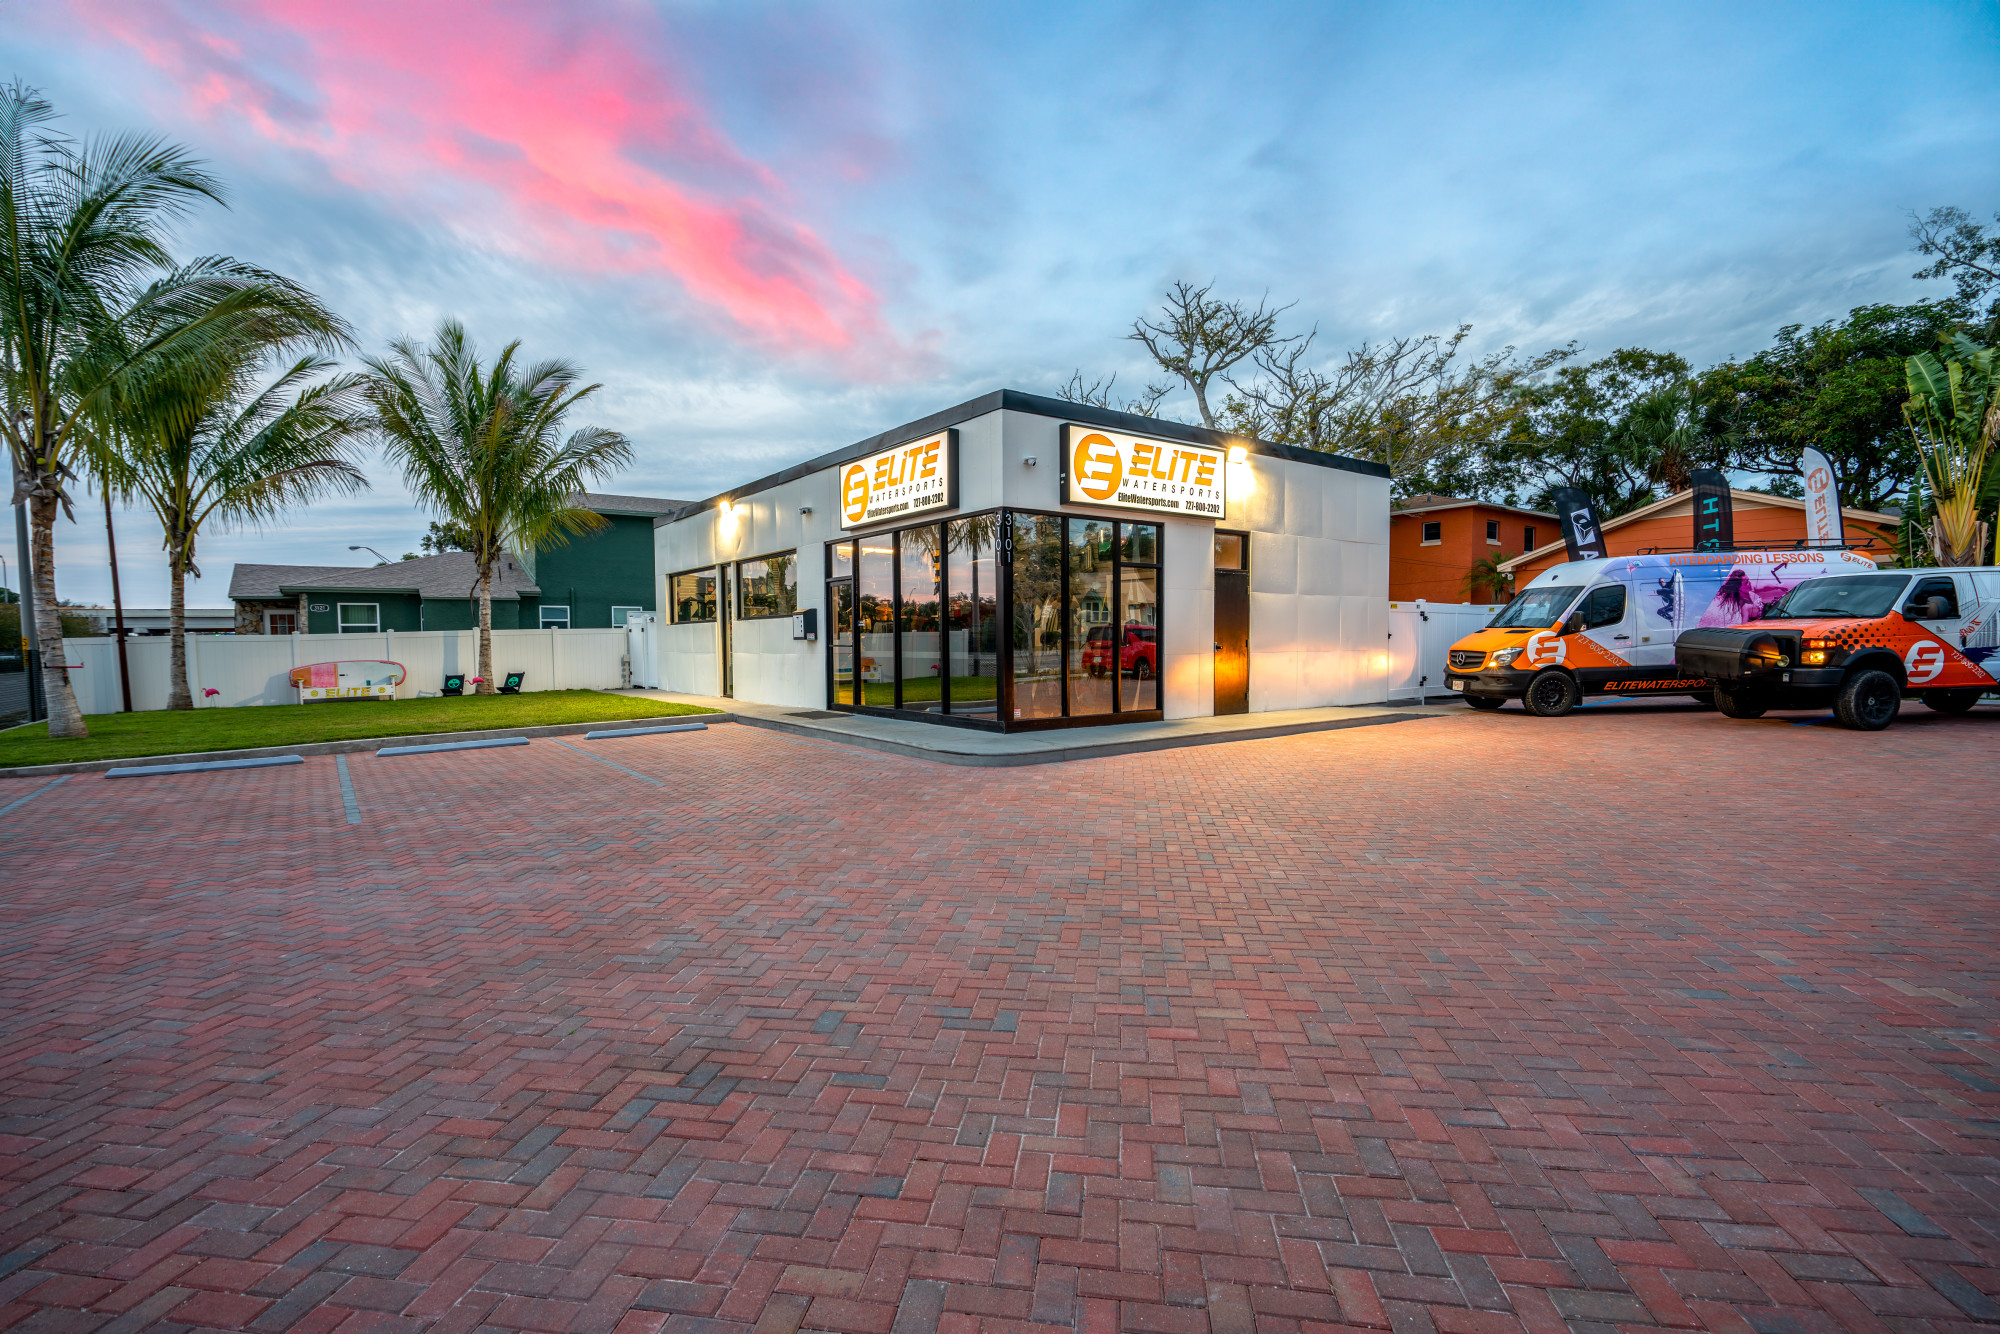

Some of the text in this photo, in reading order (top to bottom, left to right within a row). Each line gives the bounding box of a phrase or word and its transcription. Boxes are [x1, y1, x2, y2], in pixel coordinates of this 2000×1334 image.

[868, 477, 944, 504] WATERSPORTS
[1122, 477, 1220, 500] WATERSPORTS
[1117, 492, 1220, 514] EliteWatersports.com 727-800-2202
[1669, 552, 1825, 566] KITEBOARDING LESSONS
[1574, 632, 1623, 667] 727-800-2202
[1951, 650, 1986, 679] 727-800-2202
